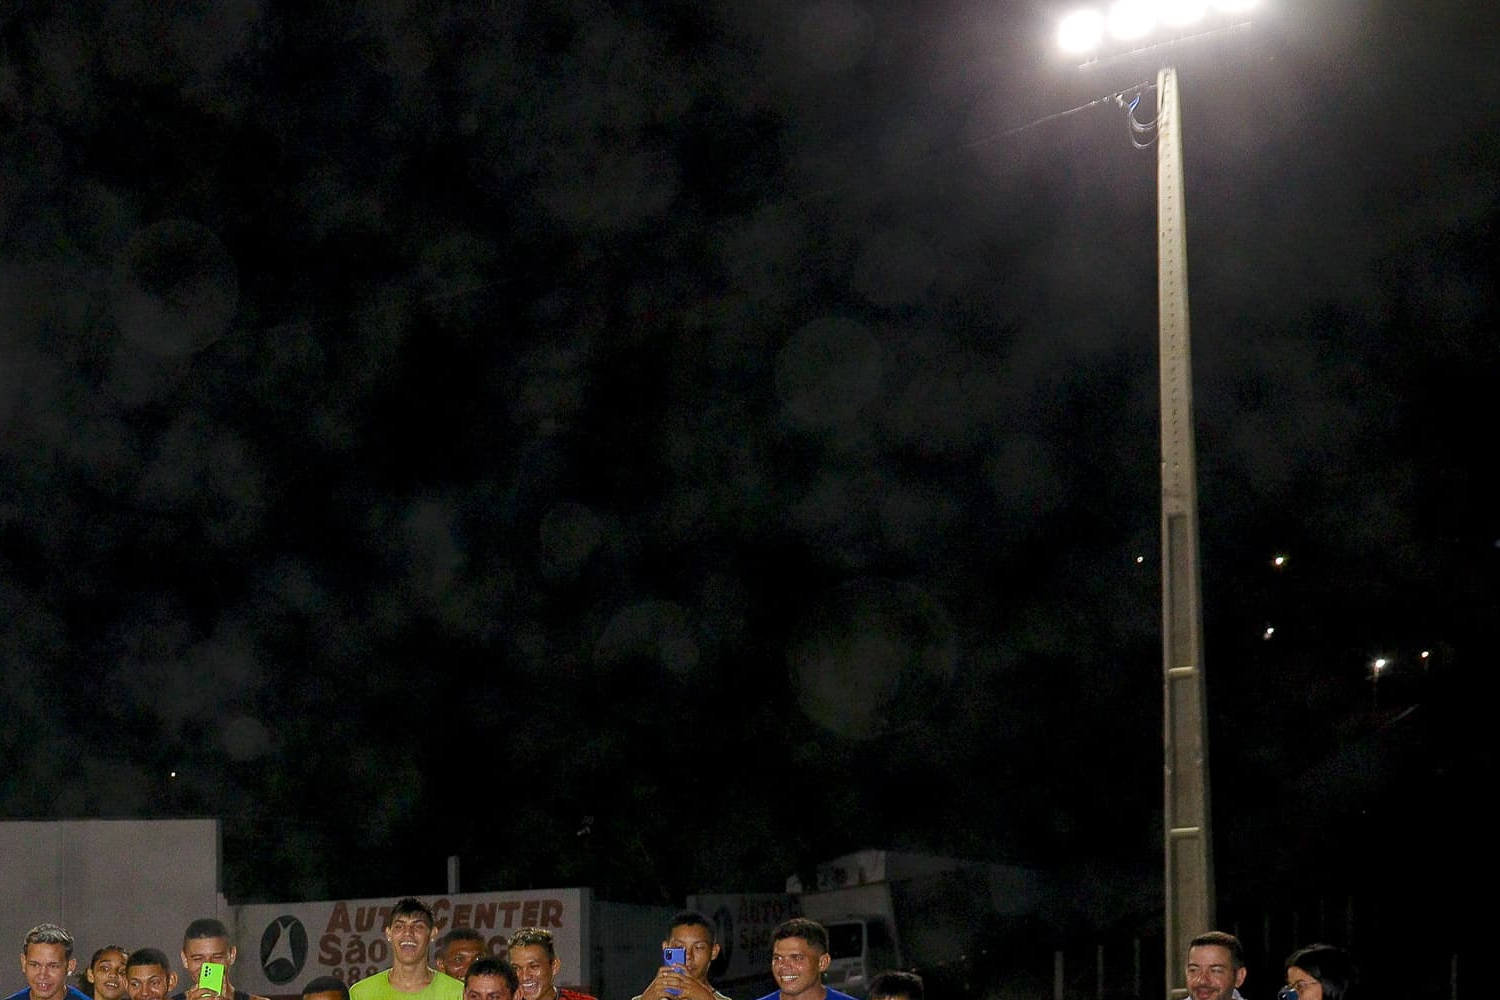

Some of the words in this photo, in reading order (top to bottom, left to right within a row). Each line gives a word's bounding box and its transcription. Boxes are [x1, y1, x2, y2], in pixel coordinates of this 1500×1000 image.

[325, 901, 390, 933] AUT
[434, 898, 563, 929] CENTER
[318, 934, 388, 966] São
